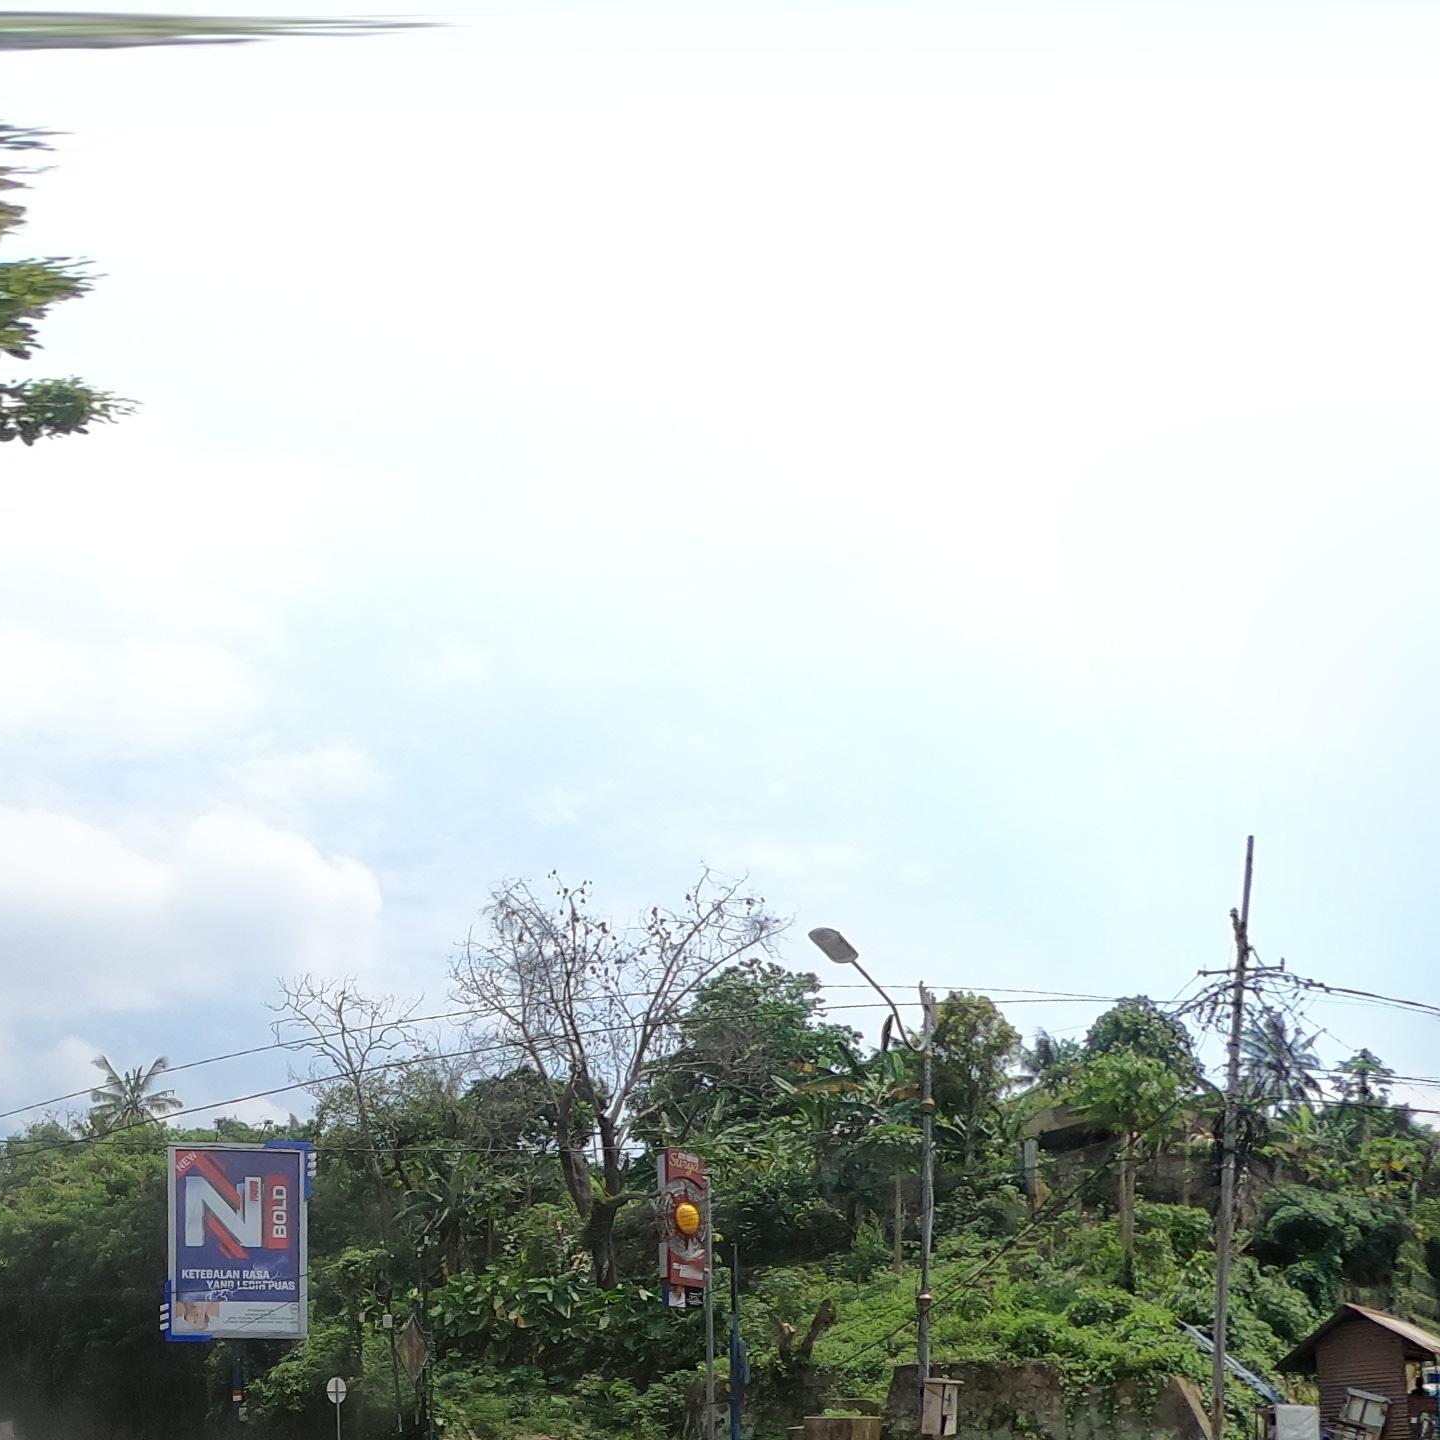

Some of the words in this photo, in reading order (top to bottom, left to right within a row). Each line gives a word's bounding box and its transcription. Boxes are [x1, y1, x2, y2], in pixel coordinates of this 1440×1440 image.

[175, 1151, 198, 1173] NEW
[272, 1185, 287, 1239] BOLD
[181, 1268, 241, 1280] KETEBALAN
[242, 1269, 271, 1281] RASA
[268, 1281, 296, 1291] PUAS
